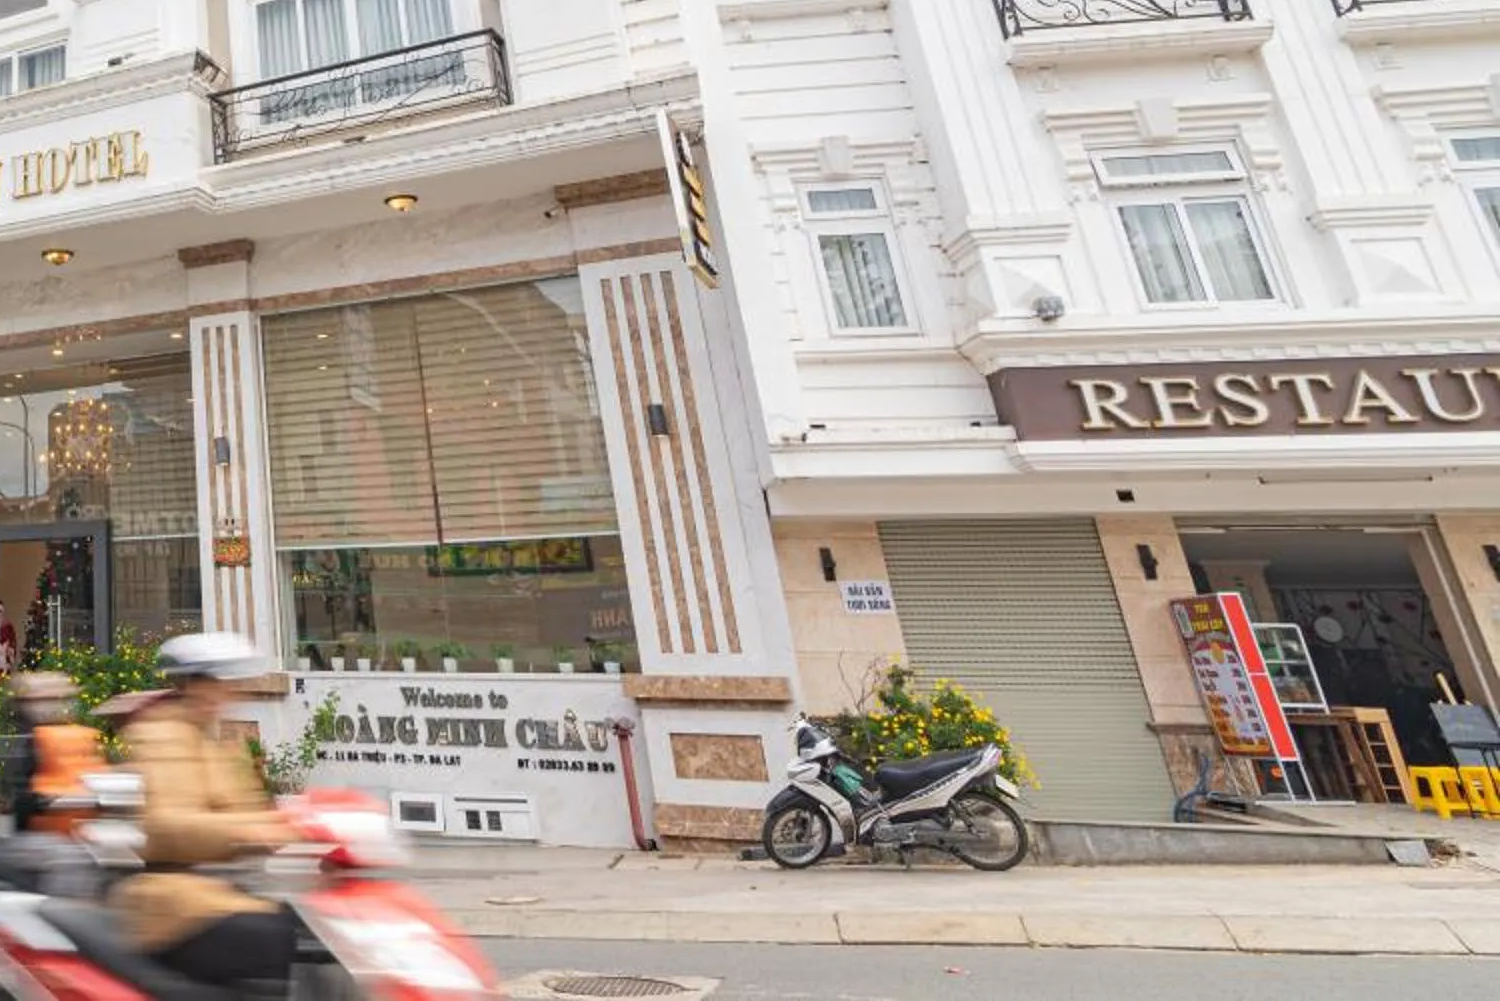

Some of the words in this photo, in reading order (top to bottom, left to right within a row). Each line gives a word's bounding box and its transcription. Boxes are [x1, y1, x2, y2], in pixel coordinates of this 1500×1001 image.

[11, 128, 149, 200] HOTEL
[1068, 366, 1500, 432] RESTAU
[400, 686, 483, 710] Welcome
[488, 689, 509, 710] to
[425, 717, 509, 748] MINH
[515, 708, 609, 752] CHÂU
